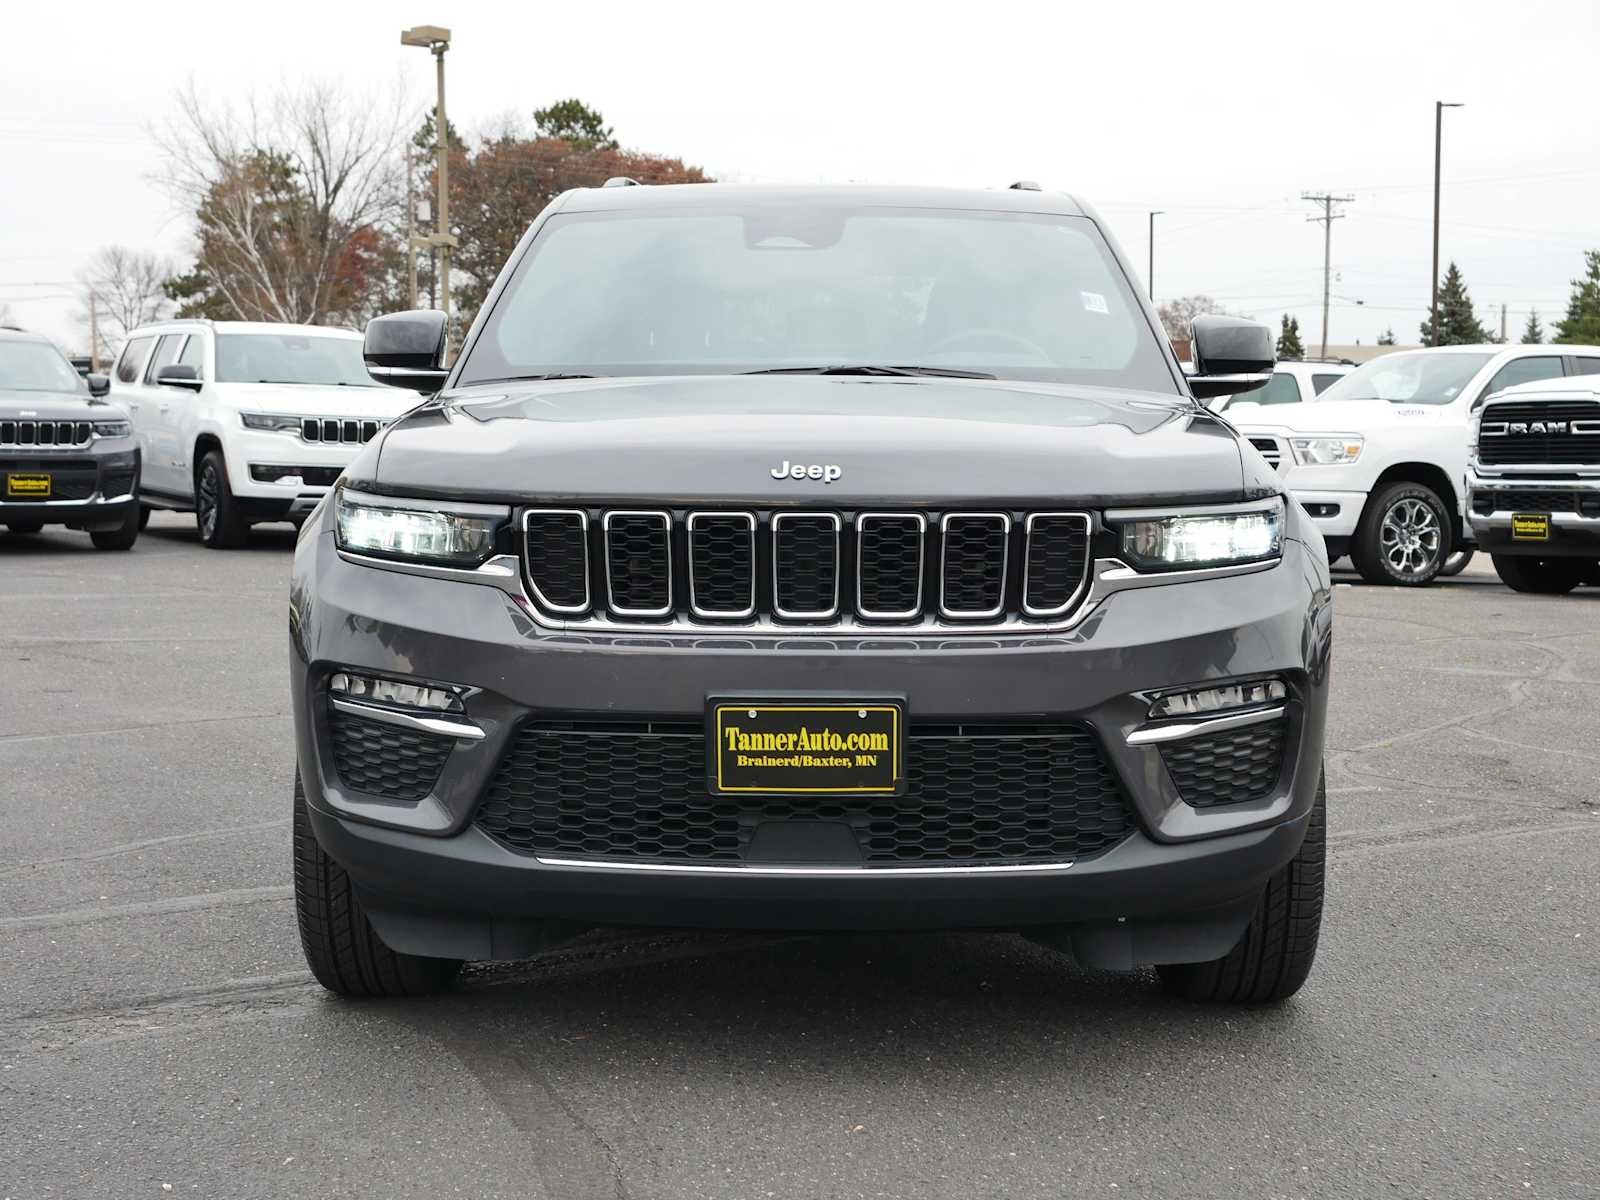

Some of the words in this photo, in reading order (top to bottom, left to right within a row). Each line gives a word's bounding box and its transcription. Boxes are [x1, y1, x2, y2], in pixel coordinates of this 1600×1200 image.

[1509, 421, 1567, 434] RAM
[771, 460, 842, 484] Jeep
[725, 727, 889, 752] TannerAuto.com
[736, 755, 853, 769] Brainerd/Baxter,
[855, 755, 878, 767] MN
